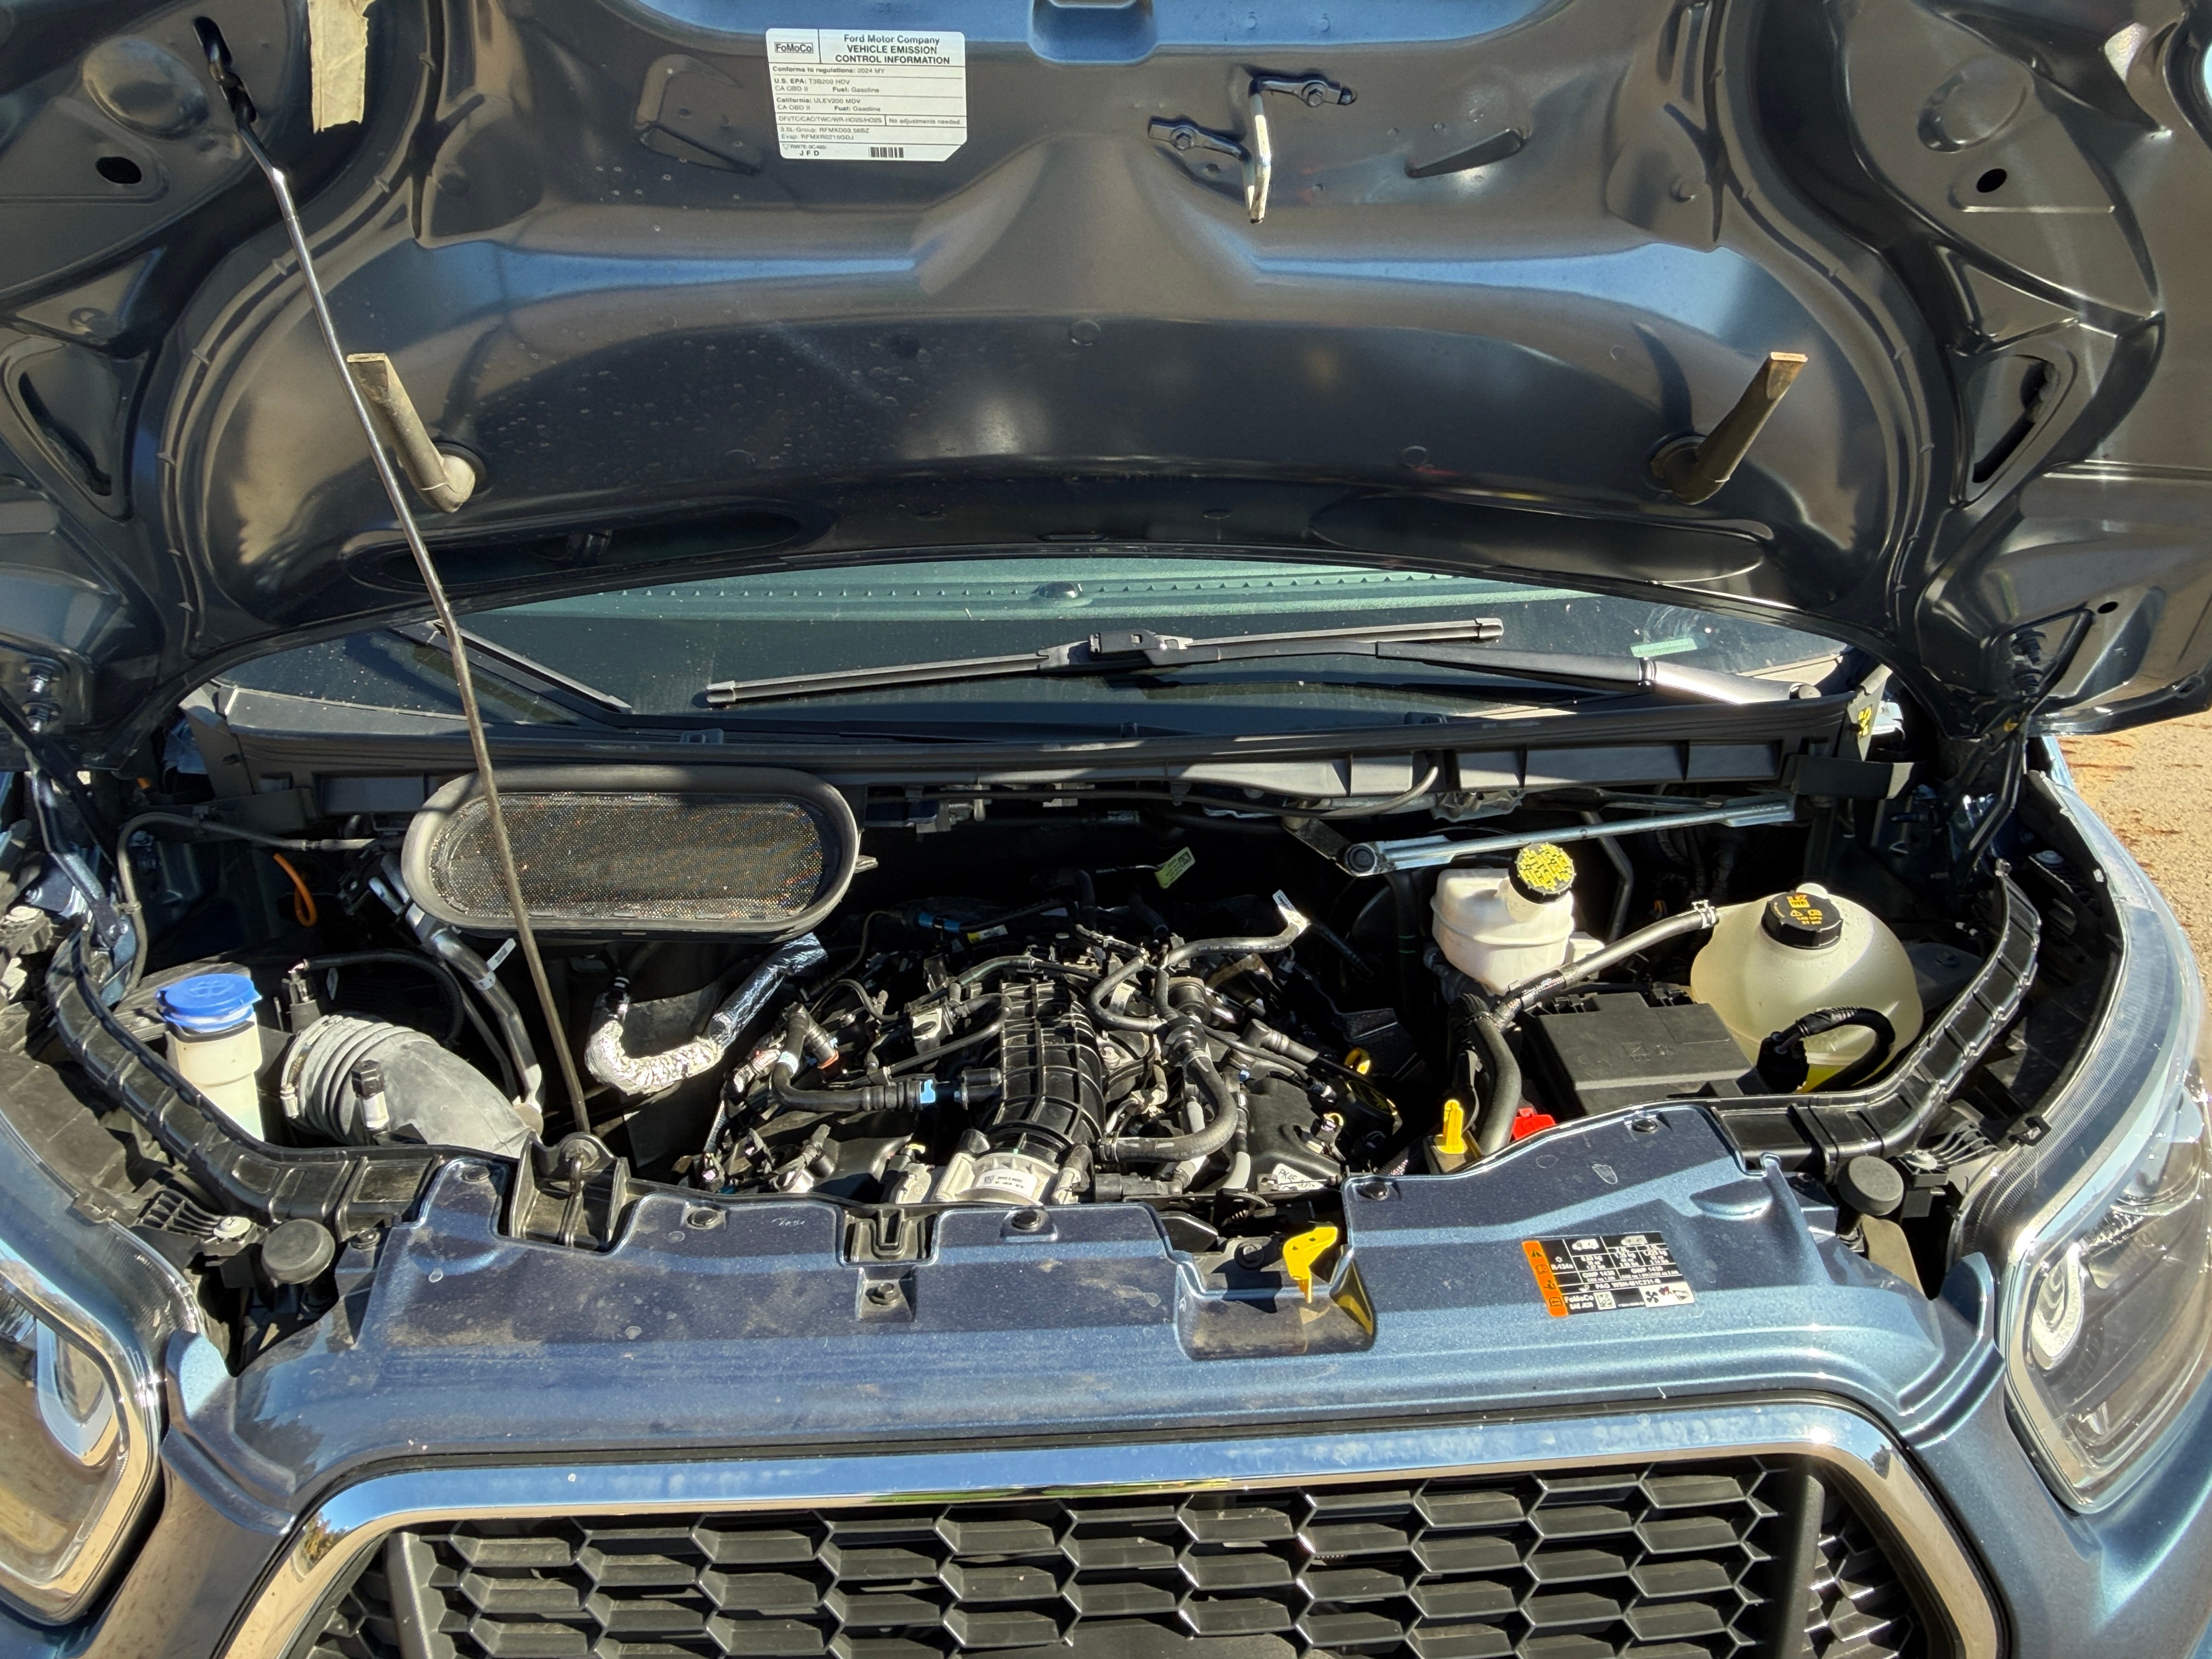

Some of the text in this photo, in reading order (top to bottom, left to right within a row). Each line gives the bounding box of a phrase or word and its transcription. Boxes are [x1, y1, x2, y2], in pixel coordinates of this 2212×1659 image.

[844, 34, 940, 46] Ford Motor Company
[776, 43, 812, 52] FoMoCo
[847, 45, 937, 54] VEHICLE EMISSION
[835, 54, 950, 65] CONTROL INFORMATION
[1564, 1294, 1594, 1304] FoMoCo
